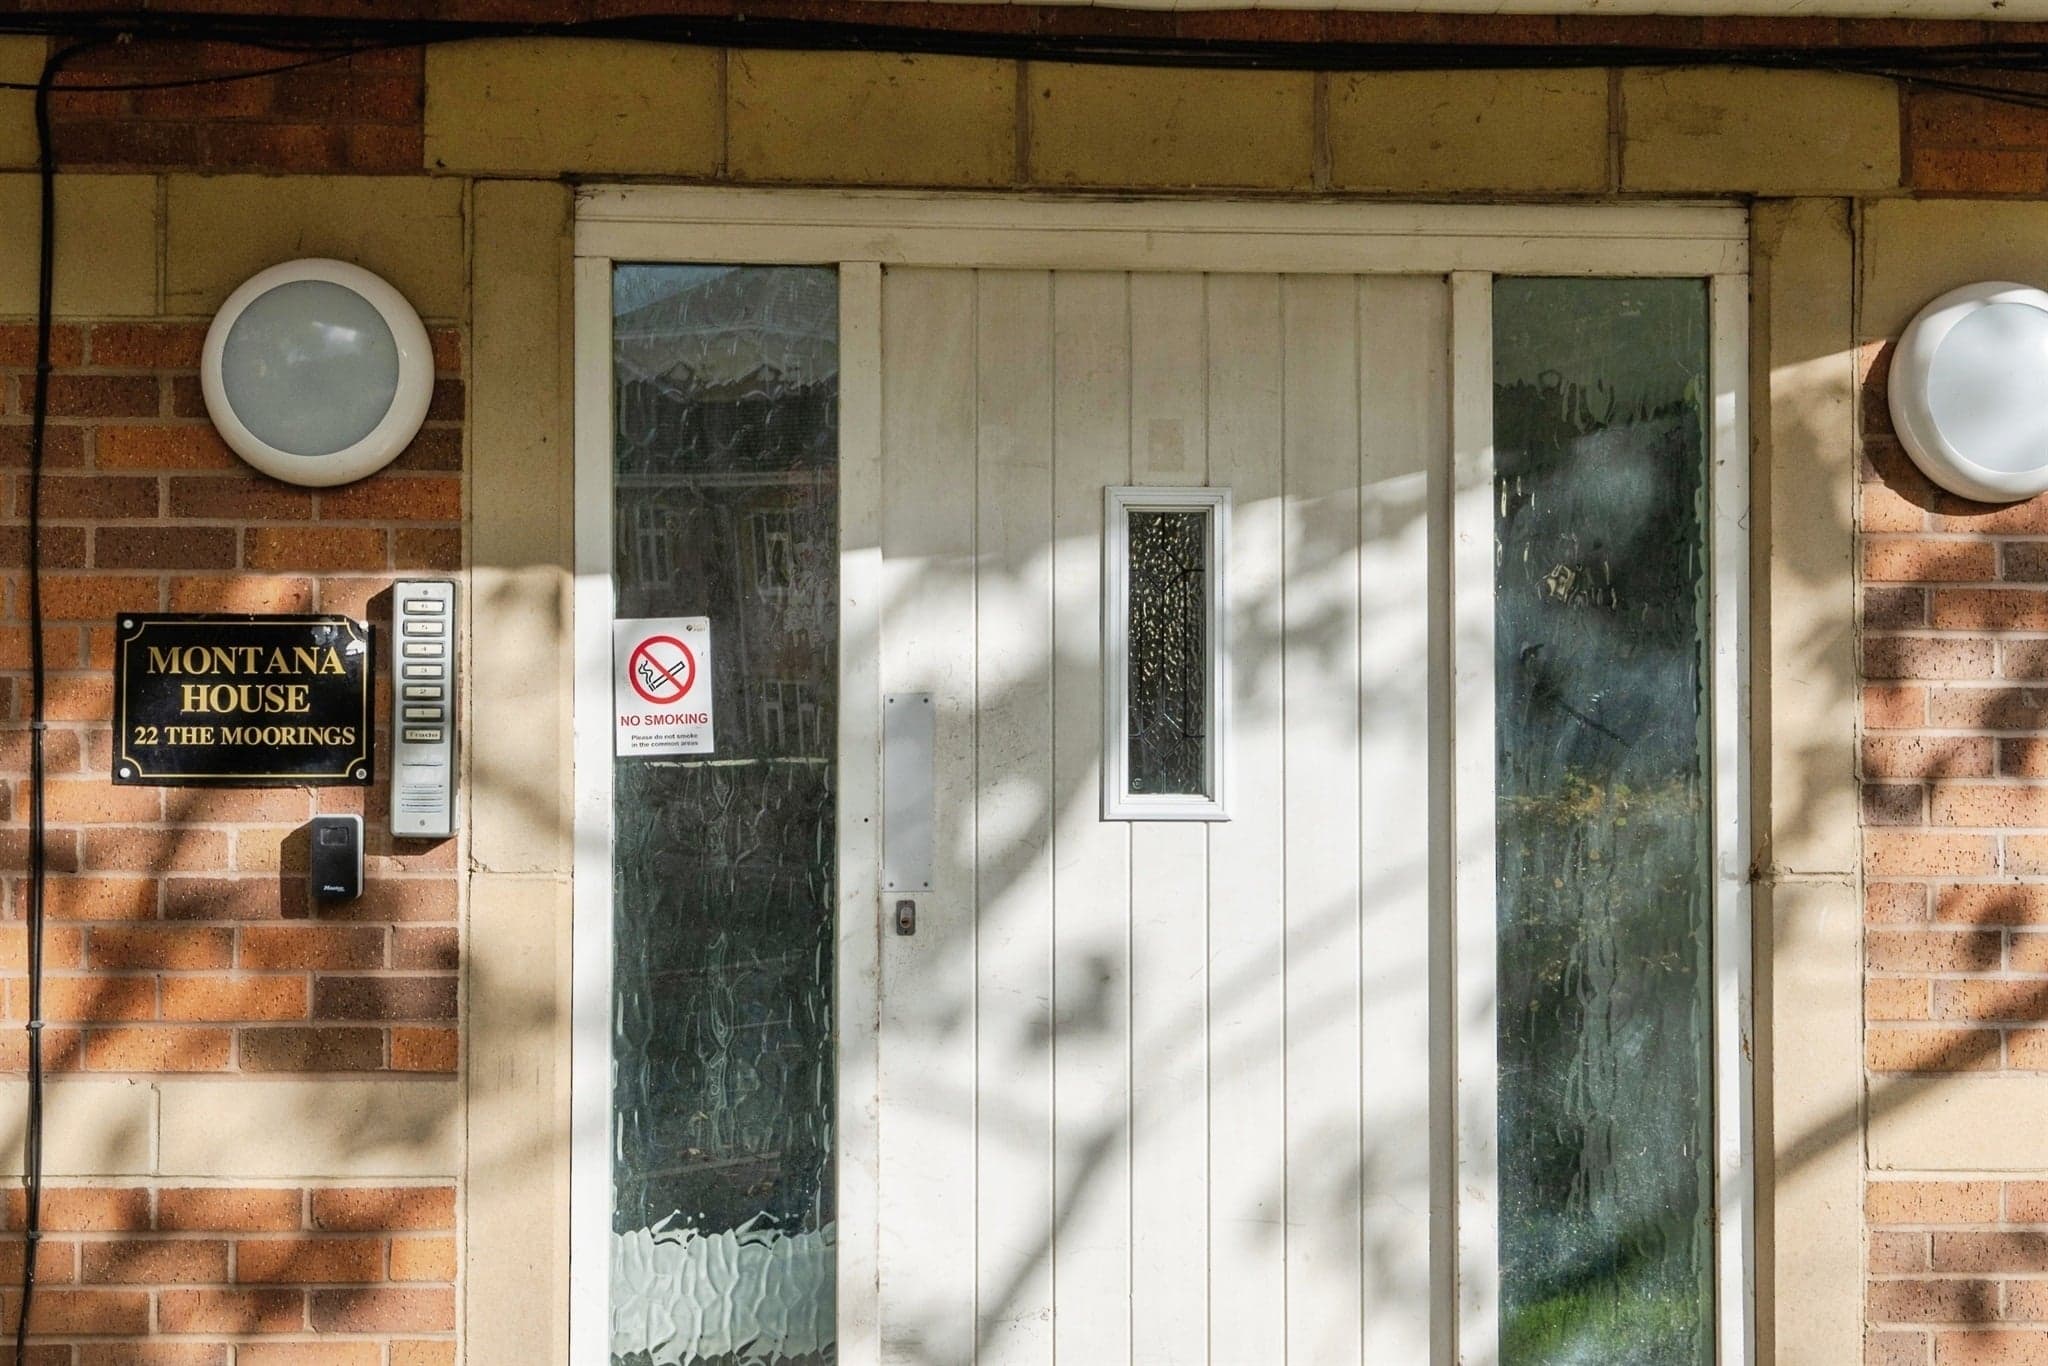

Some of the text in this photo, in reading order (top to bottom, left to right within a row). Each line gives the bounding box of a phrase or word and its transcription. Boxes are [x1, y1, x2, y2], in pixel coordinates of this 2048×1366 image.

[147, 646, 346, 675] MONTANA
[181, 684, 311, 713] HOUSE
[620, 713, 708, 727] NO SMOKING
[134, 725, 356, 746] 22 THE MOORINGS
